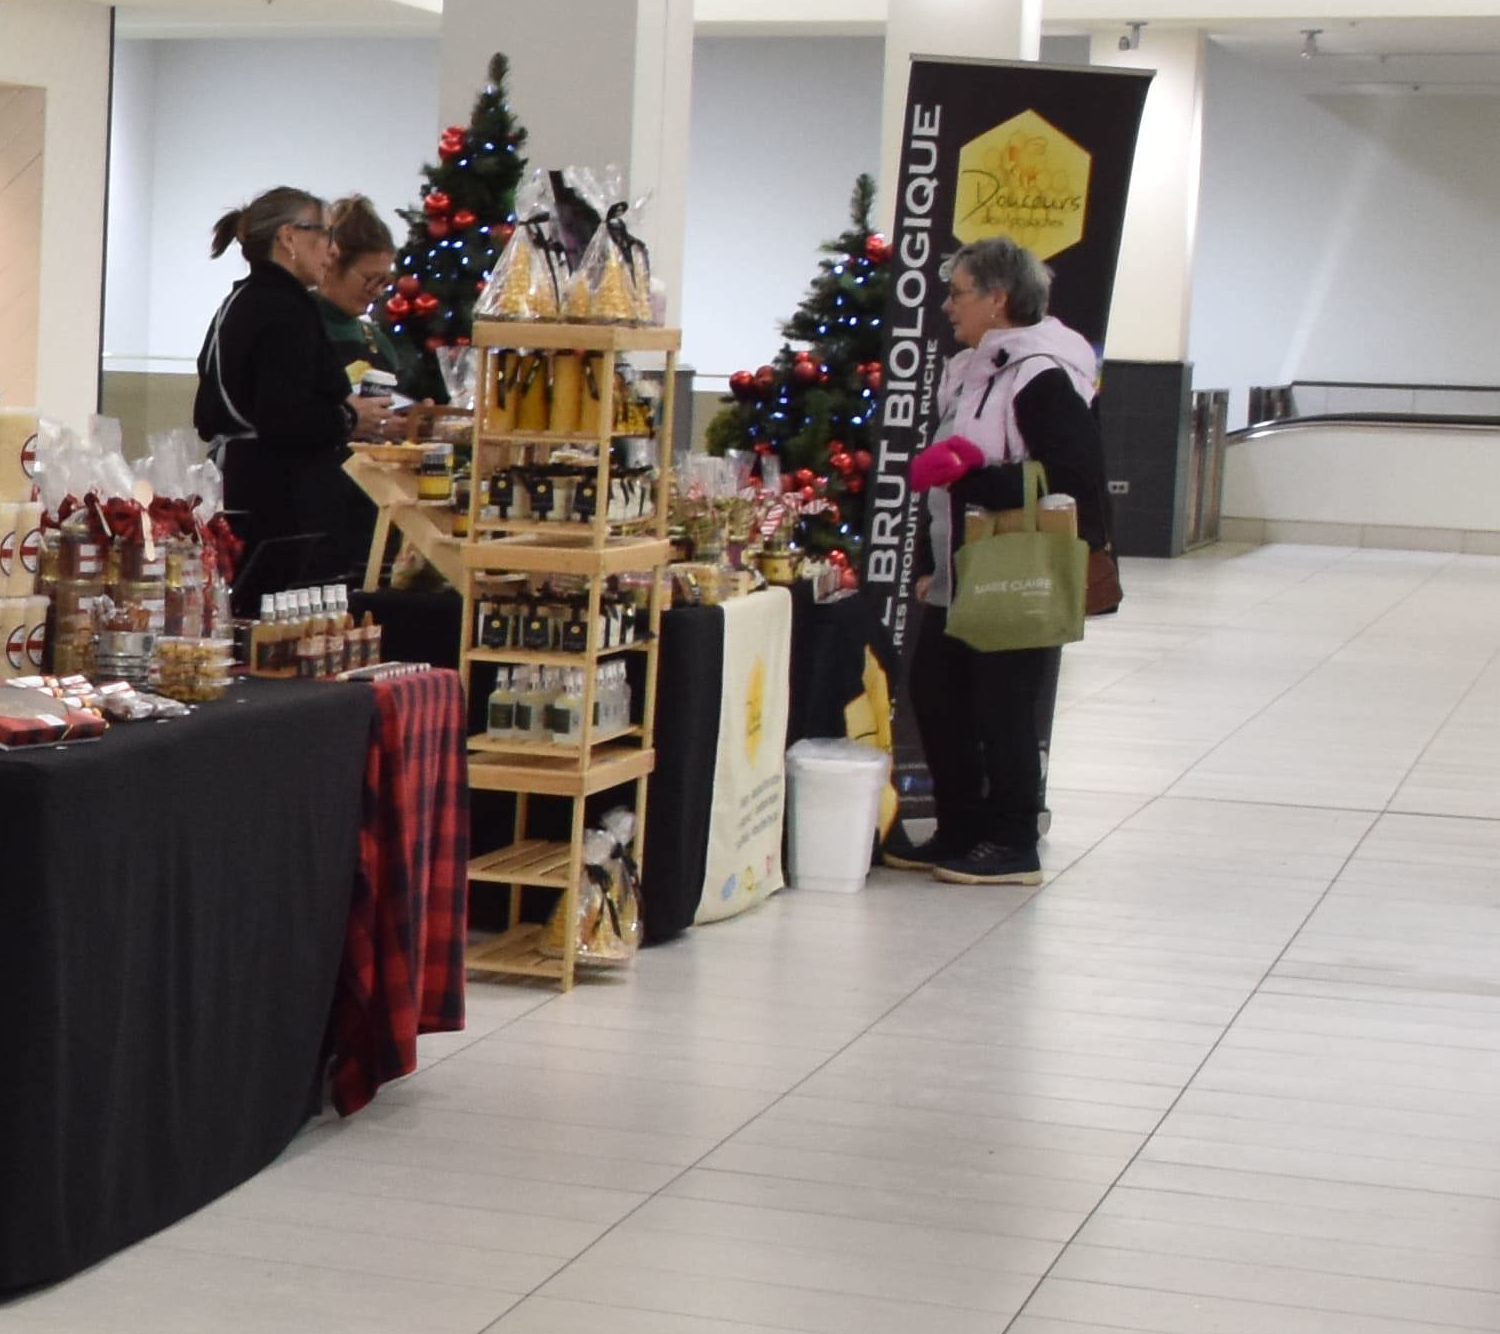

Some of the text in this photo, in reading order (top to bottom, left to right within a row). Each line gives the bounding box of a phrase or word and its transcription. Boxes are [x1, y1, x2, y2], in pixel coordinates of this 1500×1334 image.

[883, 103, 941, 427] BIOLOGIQUE
[917, 339, 938, 450] LA RUCHE
[867, 440, 908, 582] BRUT
